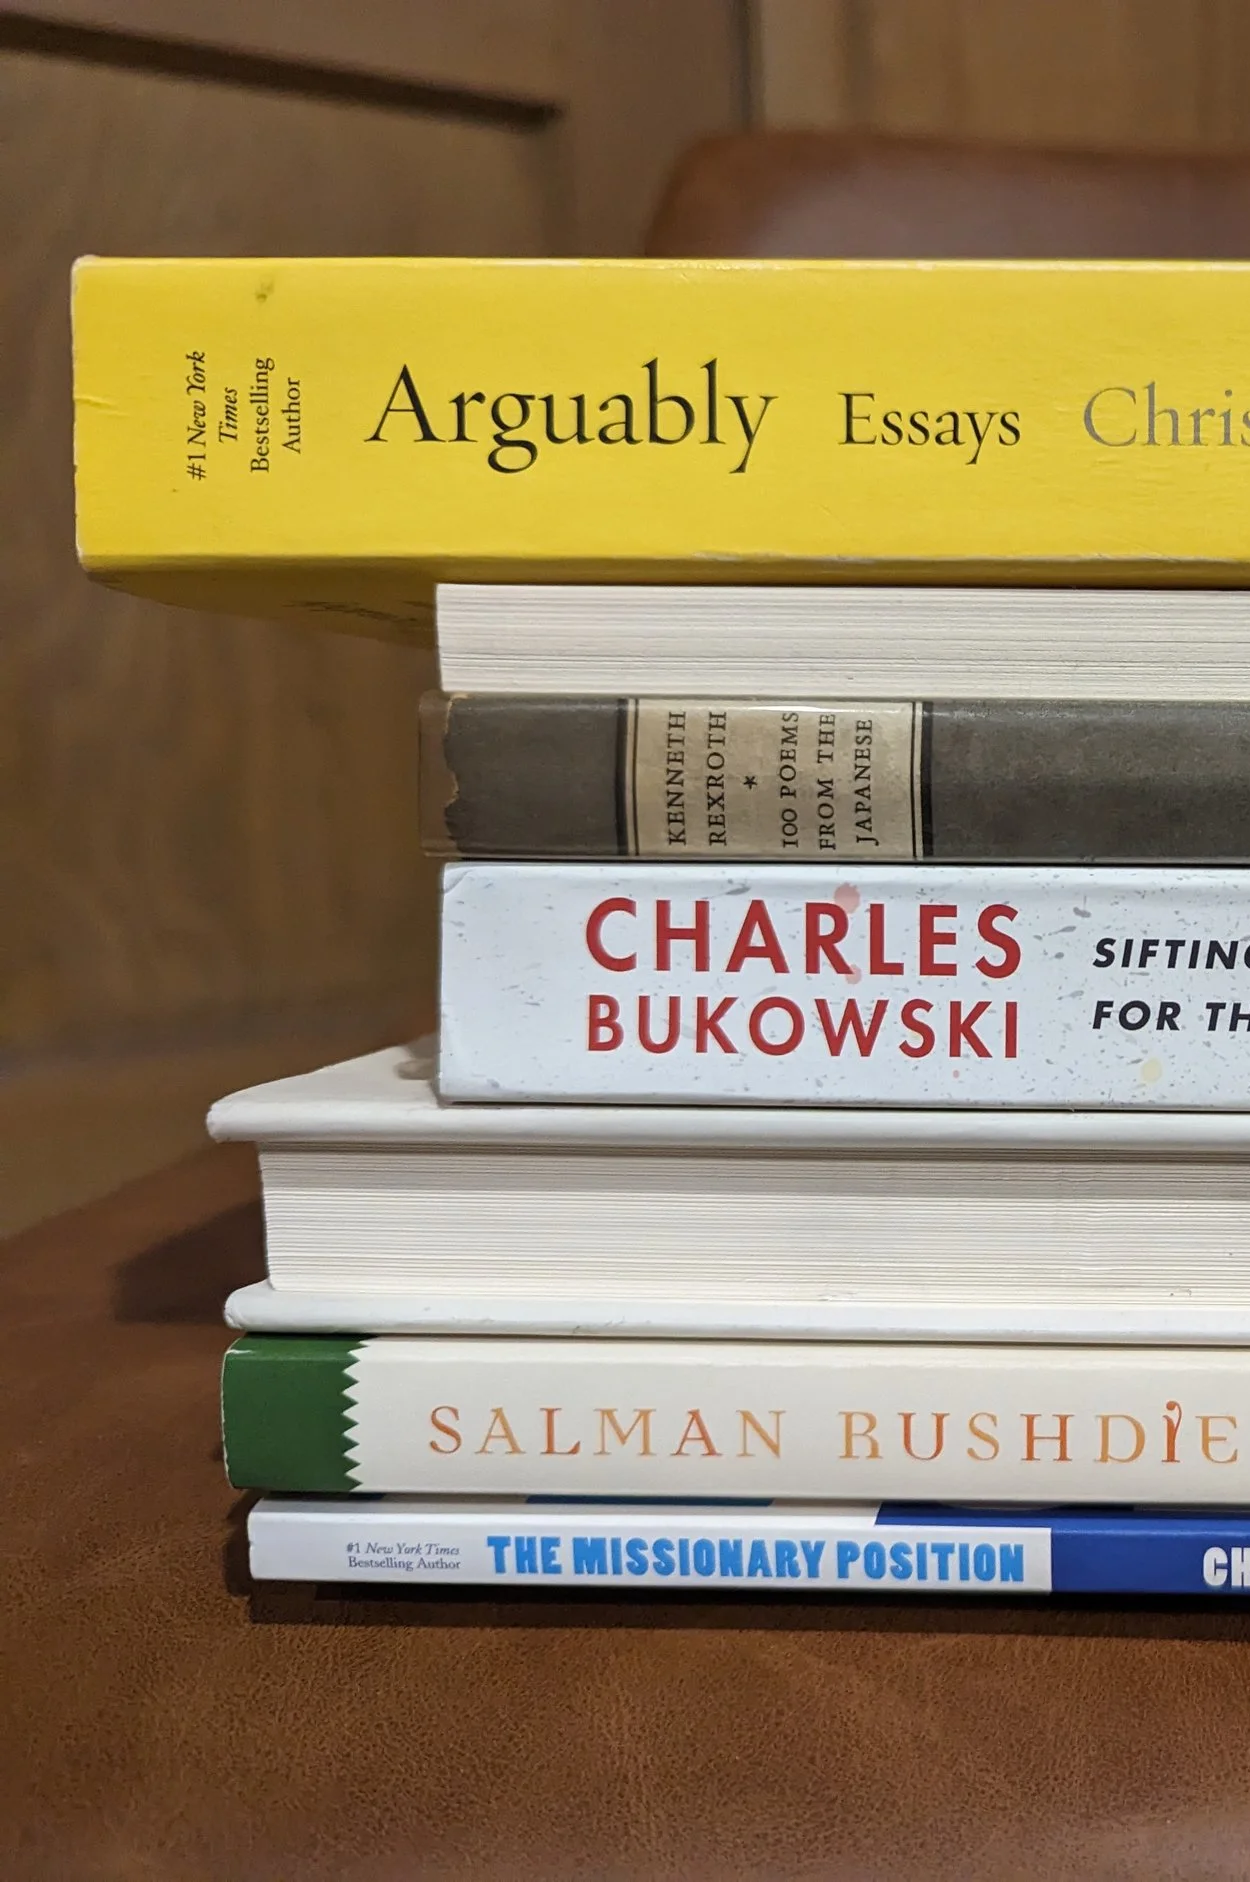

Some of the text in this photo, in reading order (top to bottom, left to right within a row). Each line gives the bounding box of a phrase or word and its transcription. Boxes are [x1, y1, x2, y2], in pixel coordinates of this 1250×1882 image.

[185, 351, 207, 480] #1 New York
[218, 387, 238, 443] Times
[249, 357, 275, 473] Bestselling
[281, 376, 301, 454] Author
[364, 356, 777, 474] Arguably
[839, 390, 1021, 465] Essays
[665, 711, 688, 845] KENNETH
[707, 711, 727, 846] REXROTH
[780, 711, 798, 799] POEMS
[816, 713, 838, 850] FROM THE
[855, 718, 879, 846] JAPANESE
[585, 897, 1022, 979] CHARLES
[587, 993, 1019, 1059] BUKOWSKI
[1093, 999, 1181, 1031] FOR
[427, 1405, 787, 1460] SALMAN
[348, 1556, 460, 1571] Bestselling Author
[365, 1542, 394, 1554] New
[396, 1542, 422, 1554] York
[425, 1543, 461, 1556] Times
[487, 1535, 1026, 1584] THE MISSIONARY POSITION
